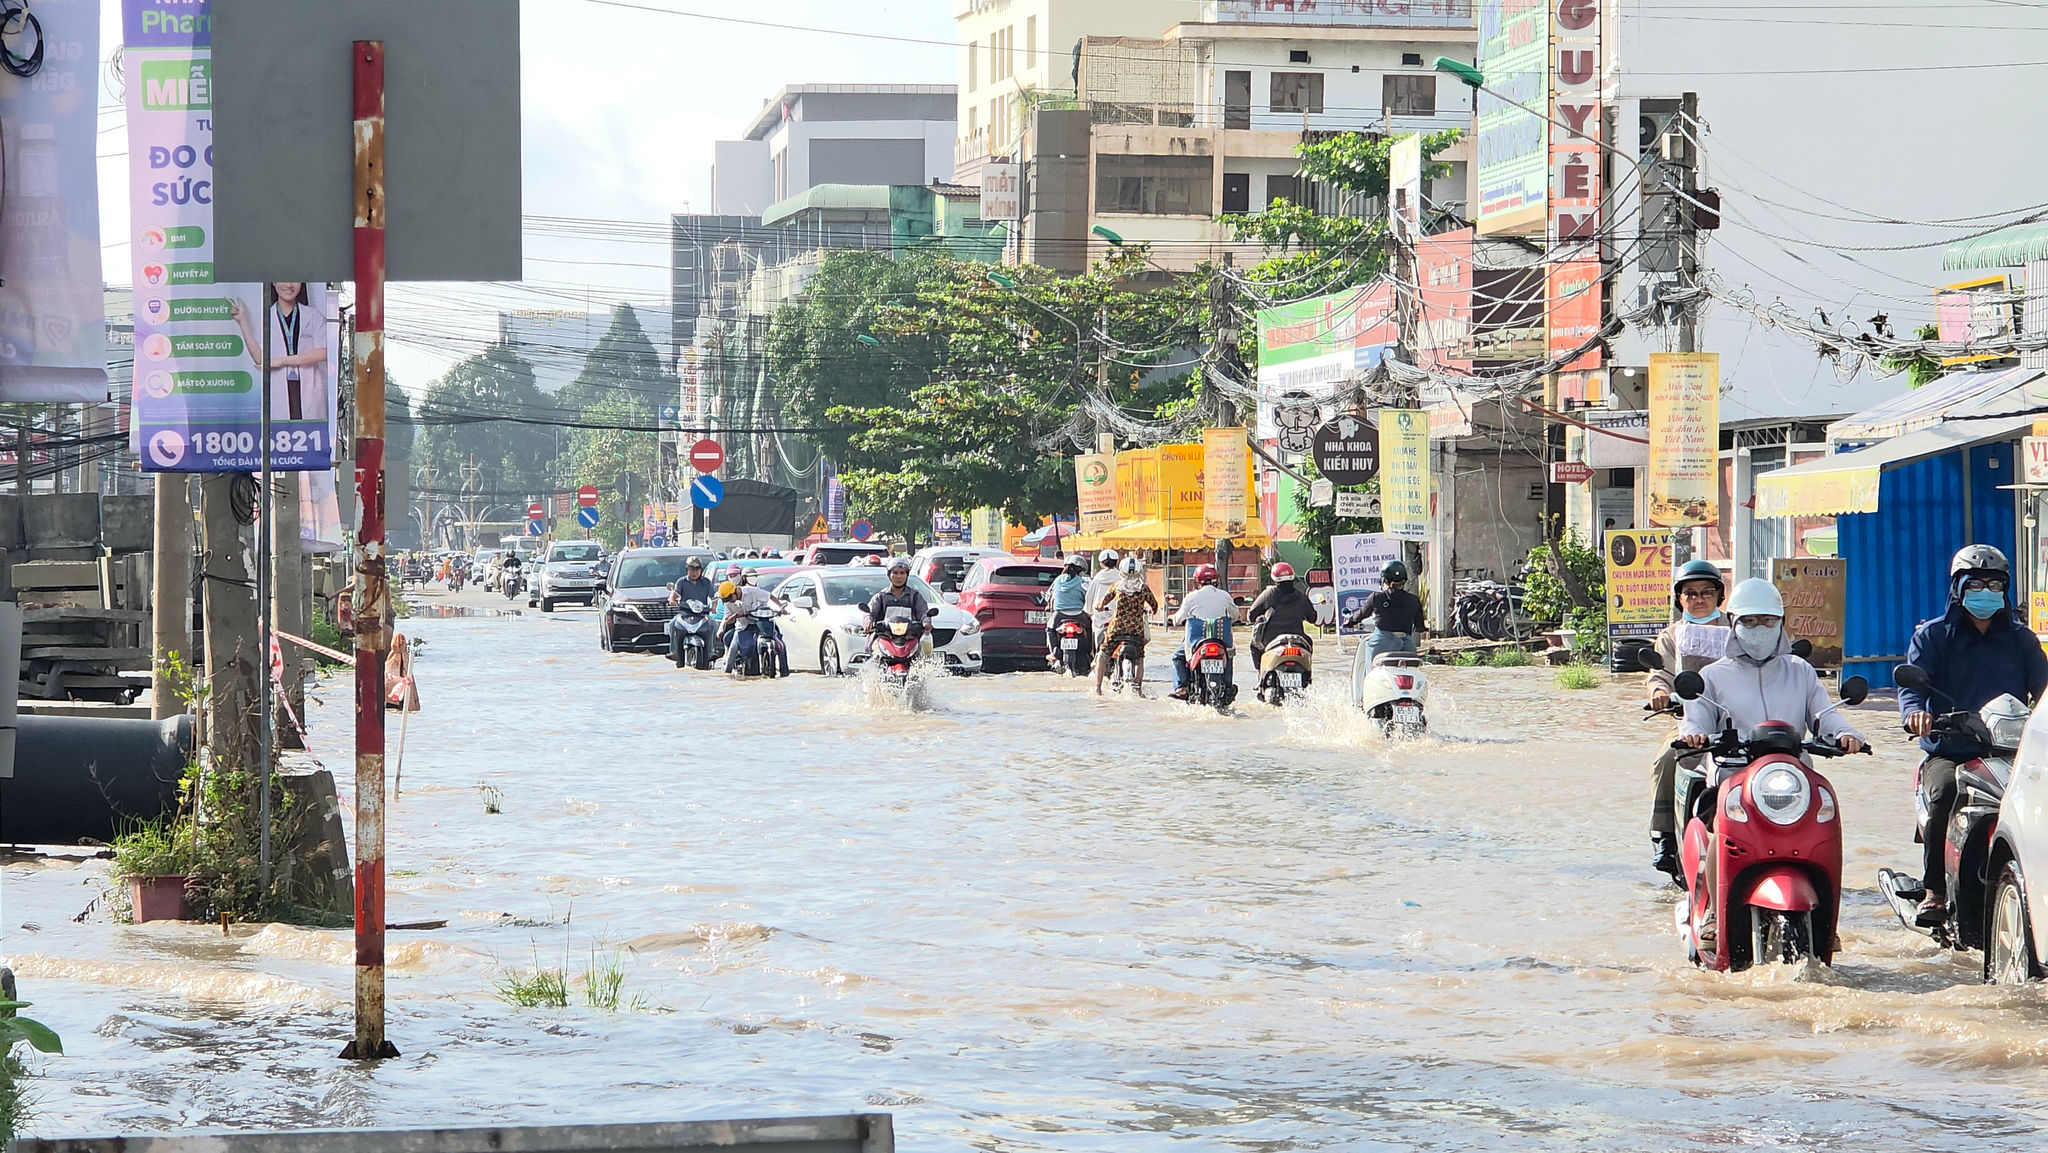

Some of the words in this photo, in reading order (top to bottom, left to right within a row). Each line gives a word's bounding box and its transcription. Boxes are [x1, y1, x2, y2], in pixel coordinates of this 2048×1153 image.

[142, 10, 211, 34] Phar
[146, 65, 212, 106] MIỄ
[149, 145, 196, 169] ĐO
[152, 175, 212, 206] SỨC
[170, 235, 186, 243] BMI
[172, 270, 198, 279] HUYẾT
[199, 270, 209, 278] ÁP
[173, 306, 202, 315] ĐƯỜNG
[203, 306, 229, 314] HUYẾT
[175, 341, 194, 350] TẦM
[195, 341, 214, 350] SOÁT
[177, 379, 194, 389] MẬT
[194, 379, 206, 388] ĐỘ
[206, 379, 235, 387] XƯƠNG
[191, 431, 253, 454] 1800
[1665, 435, 1680, 444] Việt
[1681, 435, 1705, 444] Nam
[1324, 441, 1345, 452] NHA
[1346, 441, 1372, 452] KHOA
[212, 456, 236, 466] TỔNG
[238, 456, 253, 466] ĐÀI
[254, 457, 278, 466] MN
[278, 456, 304, 465] CƯỚC
[1352, 458, 1374, 471] HUY
[1557, 464, 1586, 473] HOTEL
[1181, 491, 1204, 502] KIN
[1661, 535, 1669, 544] V
[1803, 562, 1839, 578] Café
